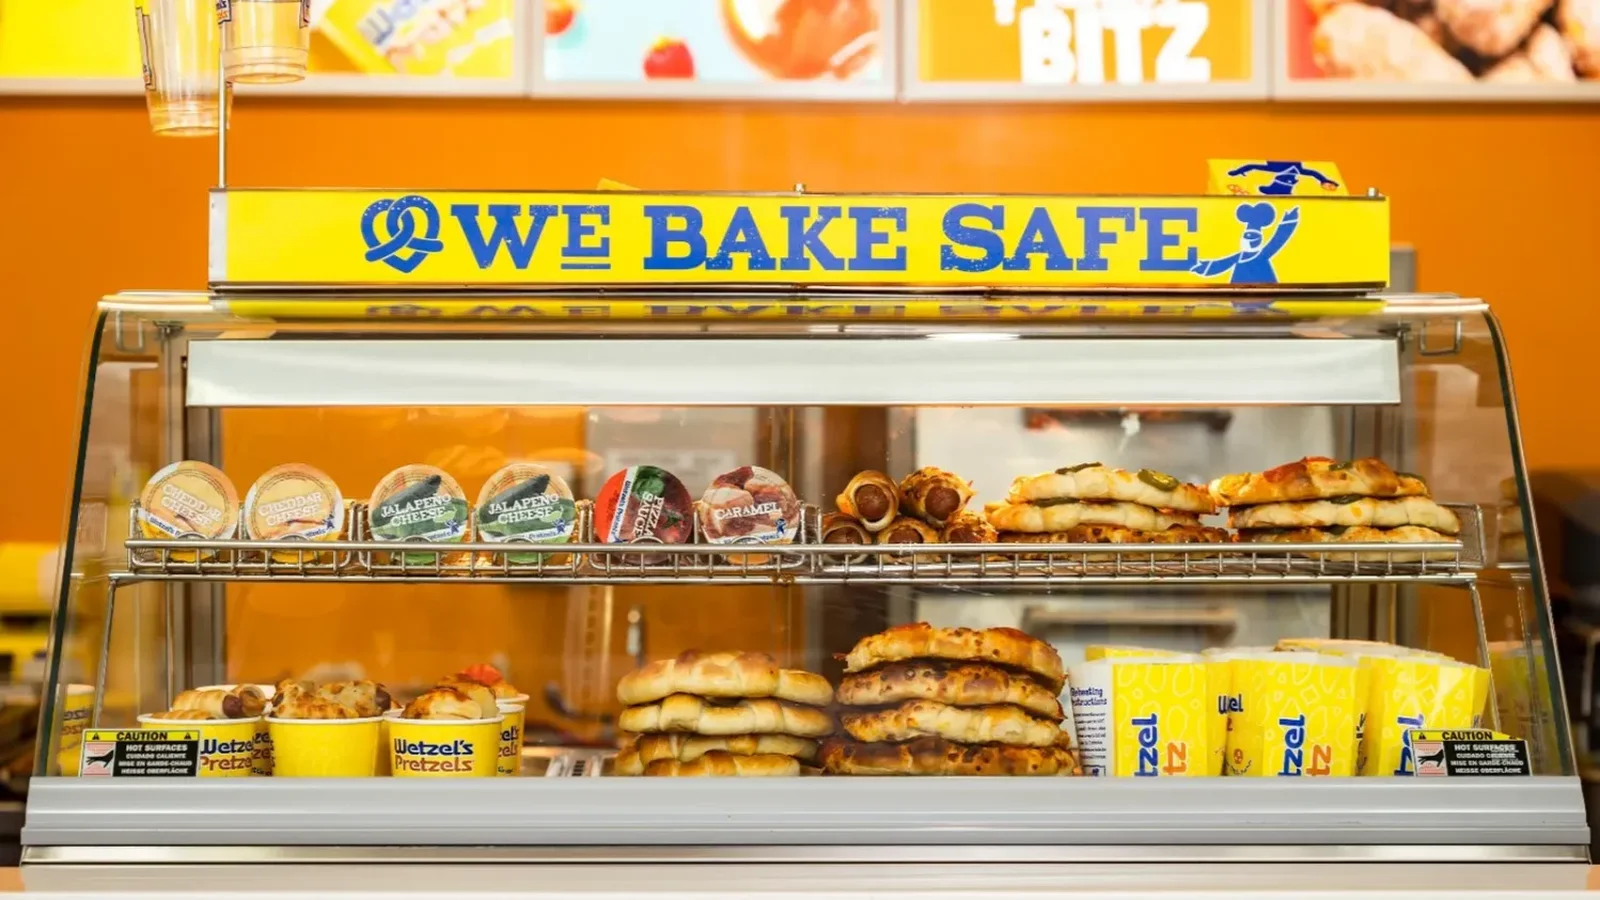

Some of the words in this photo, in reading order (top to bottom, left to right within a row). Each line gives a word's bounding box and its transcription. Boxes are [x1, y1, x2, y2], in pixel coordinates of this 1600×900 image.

[1020, 3, 1211, 83] BITZ
[451, 204, 611, 270] WE
[643, 205, 907, 271] BAKE
[941, 203, 1199, 272] SAFE
[161, 496, 213, 530] CHEESE
[162, 483, 223, 522] CHEDDAR
[258, 491, 324, 517] CHEDDAR
[714, 501, 783, 520] CARAMEL
[266, 505, 321, 526] CHEESE
[390, 506, 447, 527] CHEESE
[497, 507, 554, 525] CHEESE
[633, 492, 654, 538] SAUCE
[644, 495, 665, 538] PIZZA
[116, 731, 168, 741] CAUTION
[1442, 731, 1493, 741] CAUTION
[126, 744, 147, 752] HOT
[149, 744, 188, 752] SURFACES
[394, 739, 473, 756] Wetzel's
[1473, 744, 1516, 752] SURFACES
[395, 757, 473, 772] Pretzels
